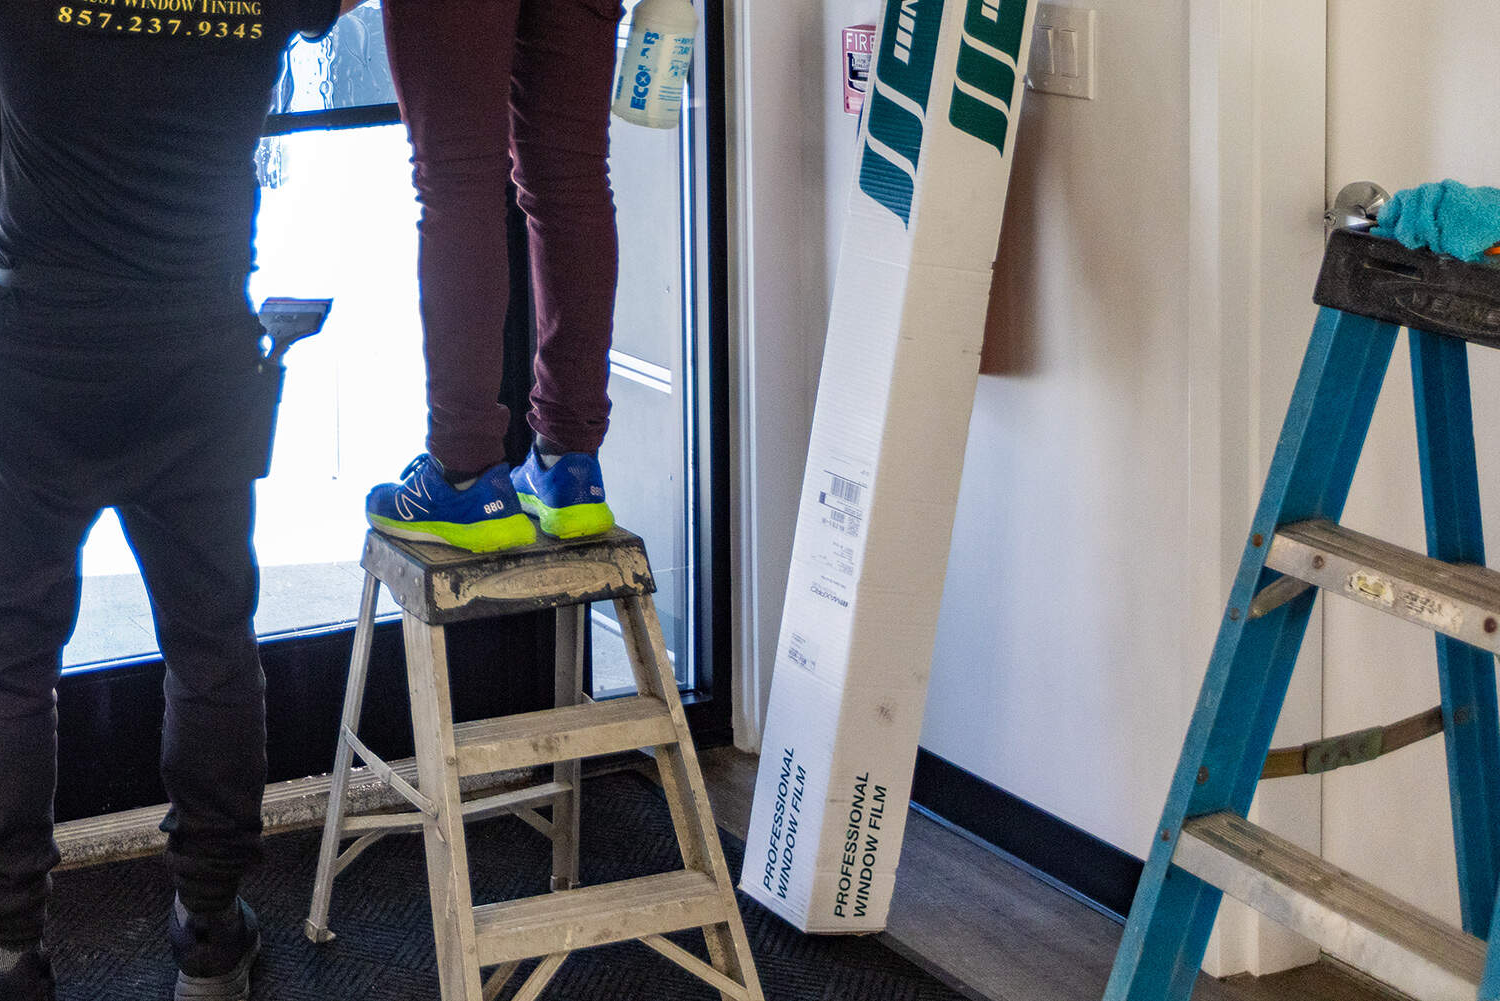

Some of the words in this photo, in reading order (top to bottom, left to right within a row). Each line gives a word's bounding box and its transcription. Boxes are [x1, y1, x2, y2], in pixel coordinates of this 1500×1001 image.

[57, 6, 263, 39] 857.237.9345
[483, 499, 505, 514] 880
[763, 747, 795, 892] PROFESSIONAL
[777, 813, 798, 900] WINDOW
[792, 764, 807, 814] FILM
[834, 772, 869, 918] PROFESSIONAL
[853, 834, 879, 917] WINDOW
[868, 785, 887, 831] FILM
